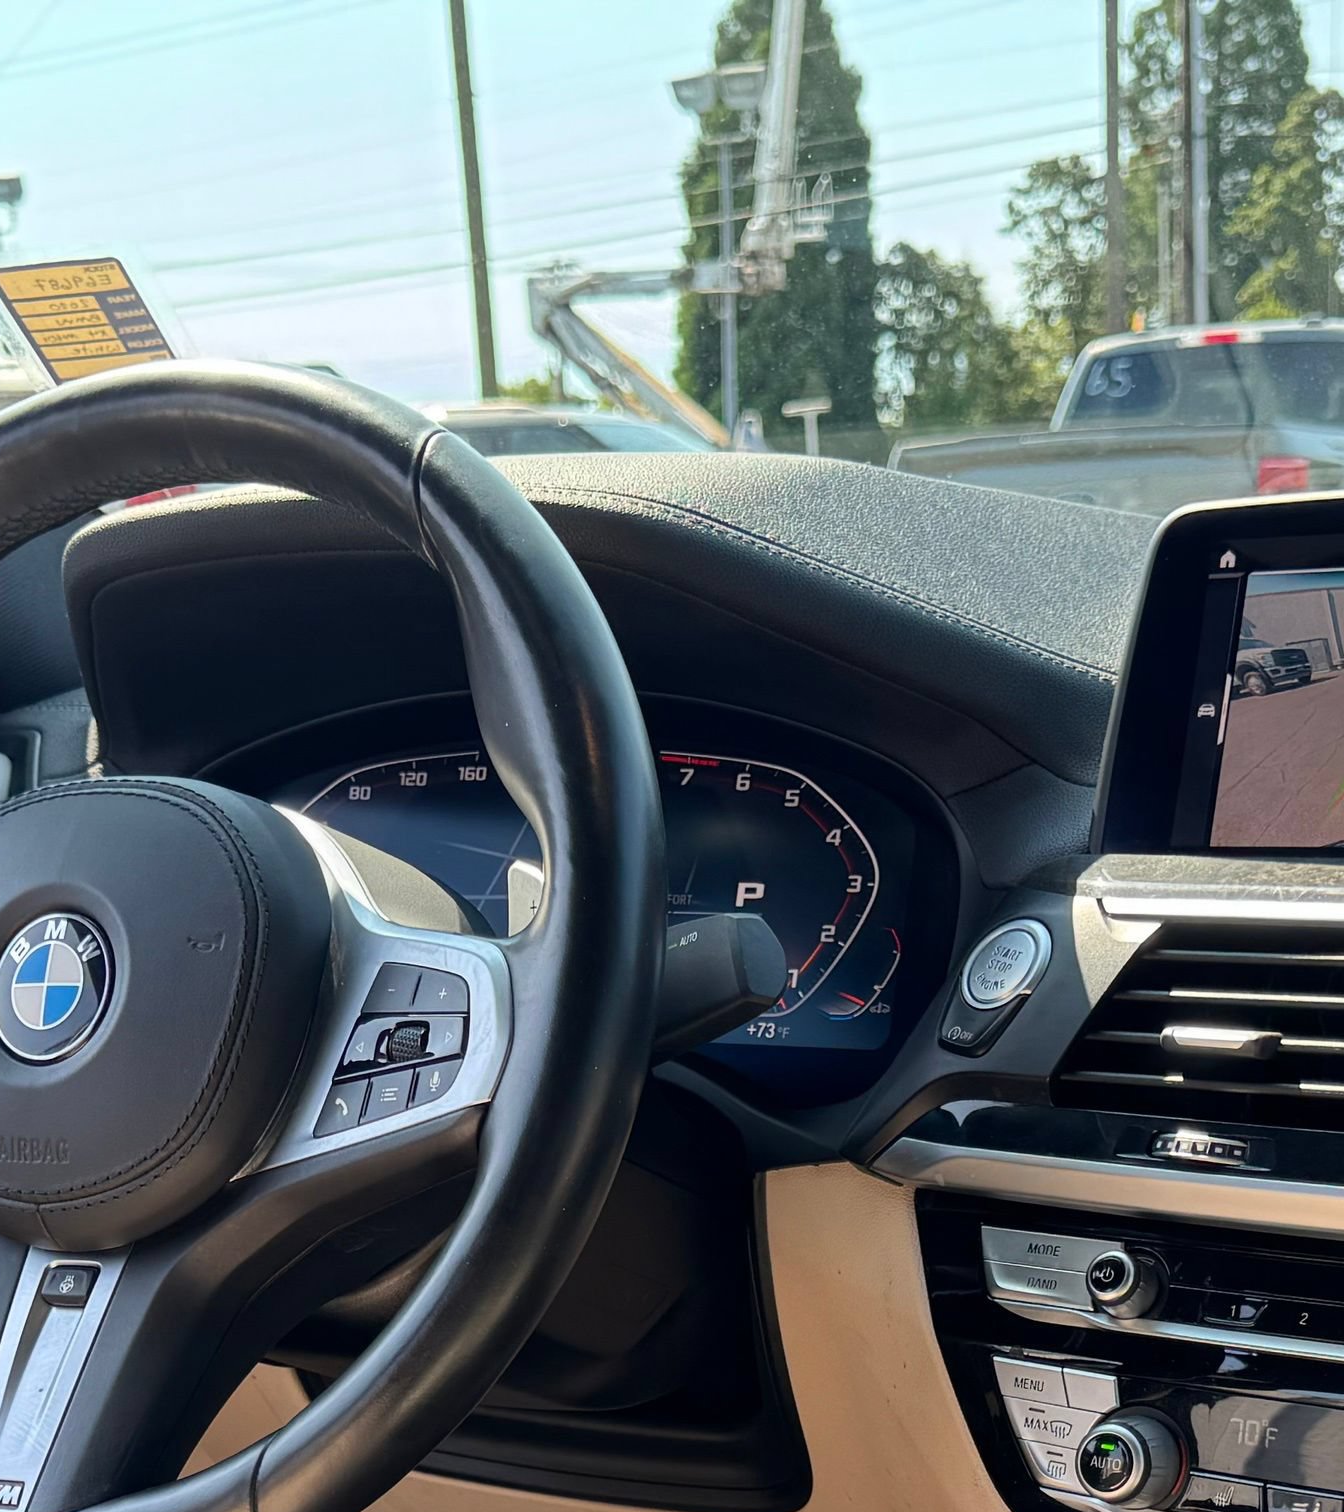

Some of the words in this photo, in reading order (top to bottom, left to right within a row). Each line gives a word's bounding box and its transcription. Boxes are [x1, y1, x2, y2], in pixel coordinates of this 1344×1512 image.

[399, 771, 428, 787] 120
[458, 766, 488, 782] 160
[679, 768, 695, 786] 7
[735, 773, 752, 792] 6
[348, 786, 372, 801] 80
[784, 790, 801, 808] 5
[825, 829, 843, 846] 4
[847, 874, 863, 893] 3
[735, 882, 766, 908] P
[10, 919, 101, 965] BMW
[679, 931, 699, 948] AUTO
[820, 925, 837, 943] 2
[993, 945, 1024, 962] START
[987, 958, 1013, 974] STOP
[787, 968, 799, 989] 1
[976, 971, 1006, 991] ENGINE
[747, 1022, 776, 1039] +73
[960, 1031, 974, 1041] OFF
[1027, 1242, 1061, 1257] MODE
[1026, 1276, 1057, 1291] BAND
[1230, 1305, 1237, 1316] 1
[1299, 1313, 1309, 1327] 2
[1013, 1376, 1045, 1393] MENU
[1023, 1416, 1049, 1432] MAX
[1090, 1455, 1122, 1471] AUTO
